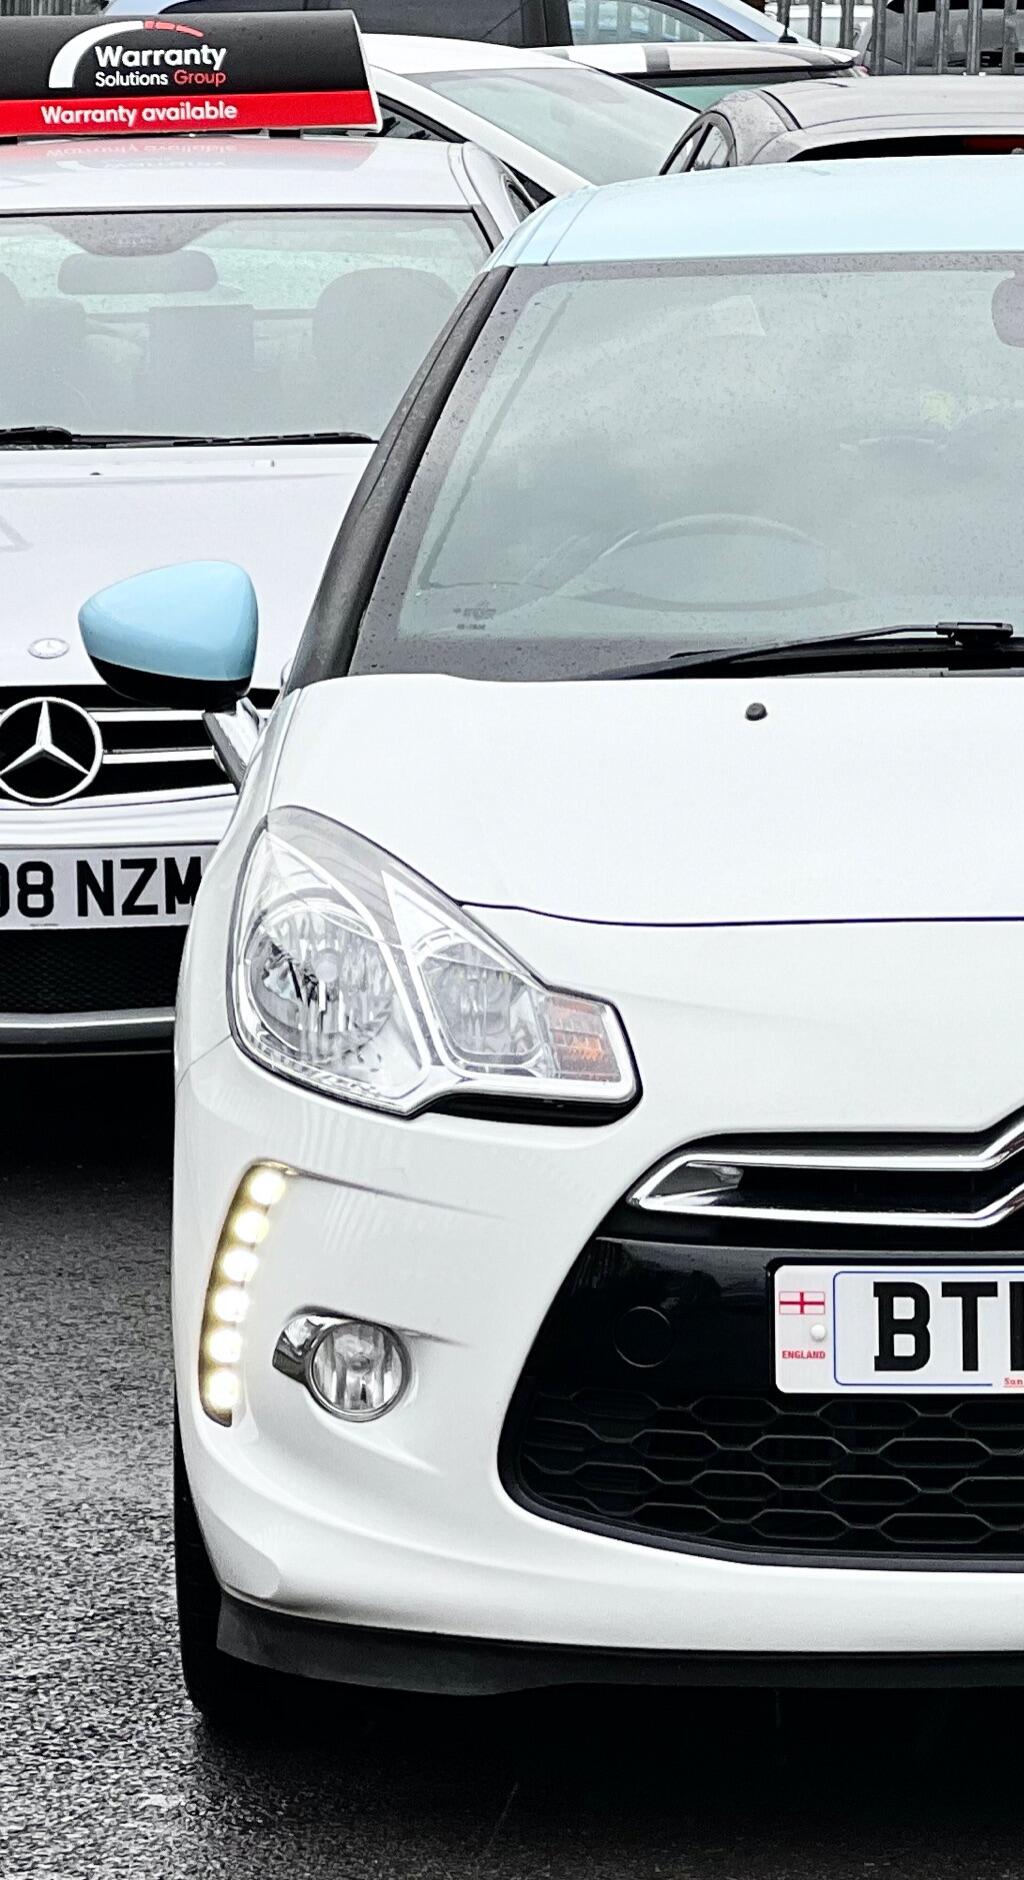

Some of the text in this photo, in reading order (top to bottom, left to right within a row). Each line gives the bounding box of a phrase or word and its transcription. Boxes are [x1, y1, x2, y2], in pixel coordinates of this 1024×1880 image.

[94, 45, 227, 71] Warranty
[95, 70, 227, 88] Solutions Group
[41, 100, 238, 127] Warranty available
[0, 856, 202, 918] 8 NZM
[782, 1350, 826, 1359] ENGLAND
